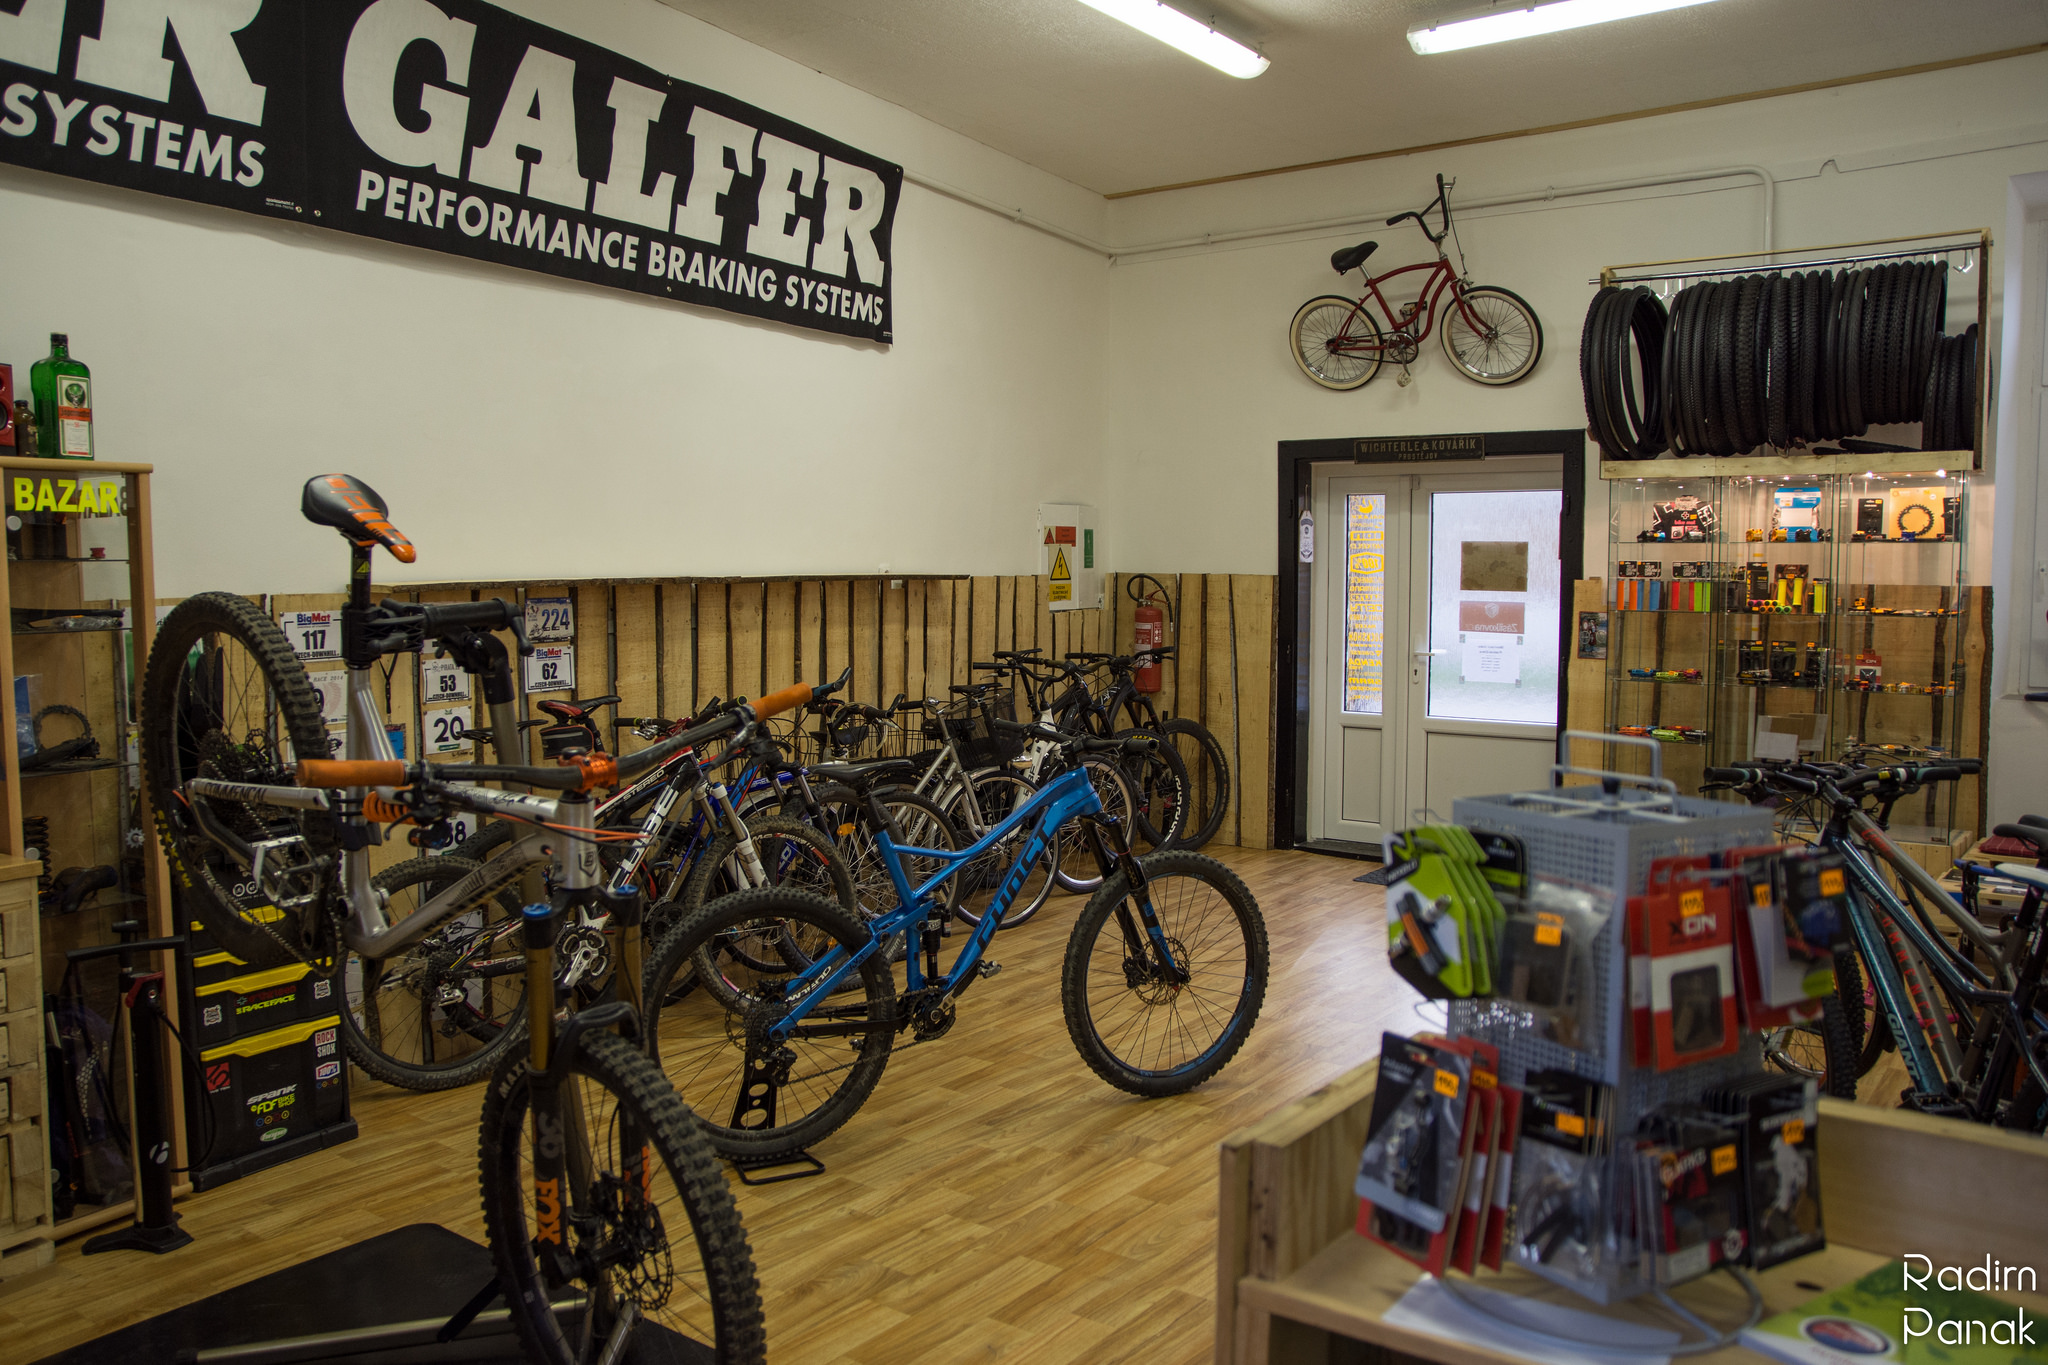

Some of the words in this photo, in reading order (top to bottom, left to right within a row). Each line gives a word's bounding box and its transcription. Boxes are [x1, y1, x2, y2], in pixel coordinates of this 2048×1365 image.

[1, 82, 267, 187] SYSTEMS
[343, 0, 886, 288] GALFER
[355, 168, 640, 271] PERFORMANCE
[647, 241, 778, 302] BRAKING
[784, 275, 884, 326] SYSTEMS
[1360, 440, 1420, 453] WICHTERLE
[1422, 441, 1429, 451] &
[14, 477, 120, 513] BAZAR
[296, 613, 331, 625] BigMat
[541, 608, 570, 631] 224
[302, 630, 326, 650] 117
[536, 648, 562, 658] BigMat
[542, 662, 558, 680] 62
[440, 674, 457, 692] 53
[433, 716, 464, 743] 20
[623, 769, 665, 802] STEREO
[316, 1029, 335, 1045] ROCK
[1887, 1012, 1920, 1080] GIANT
[316, 1042, 336, 1058] SHOX
[532, 1177, 560, 1246] FOX
